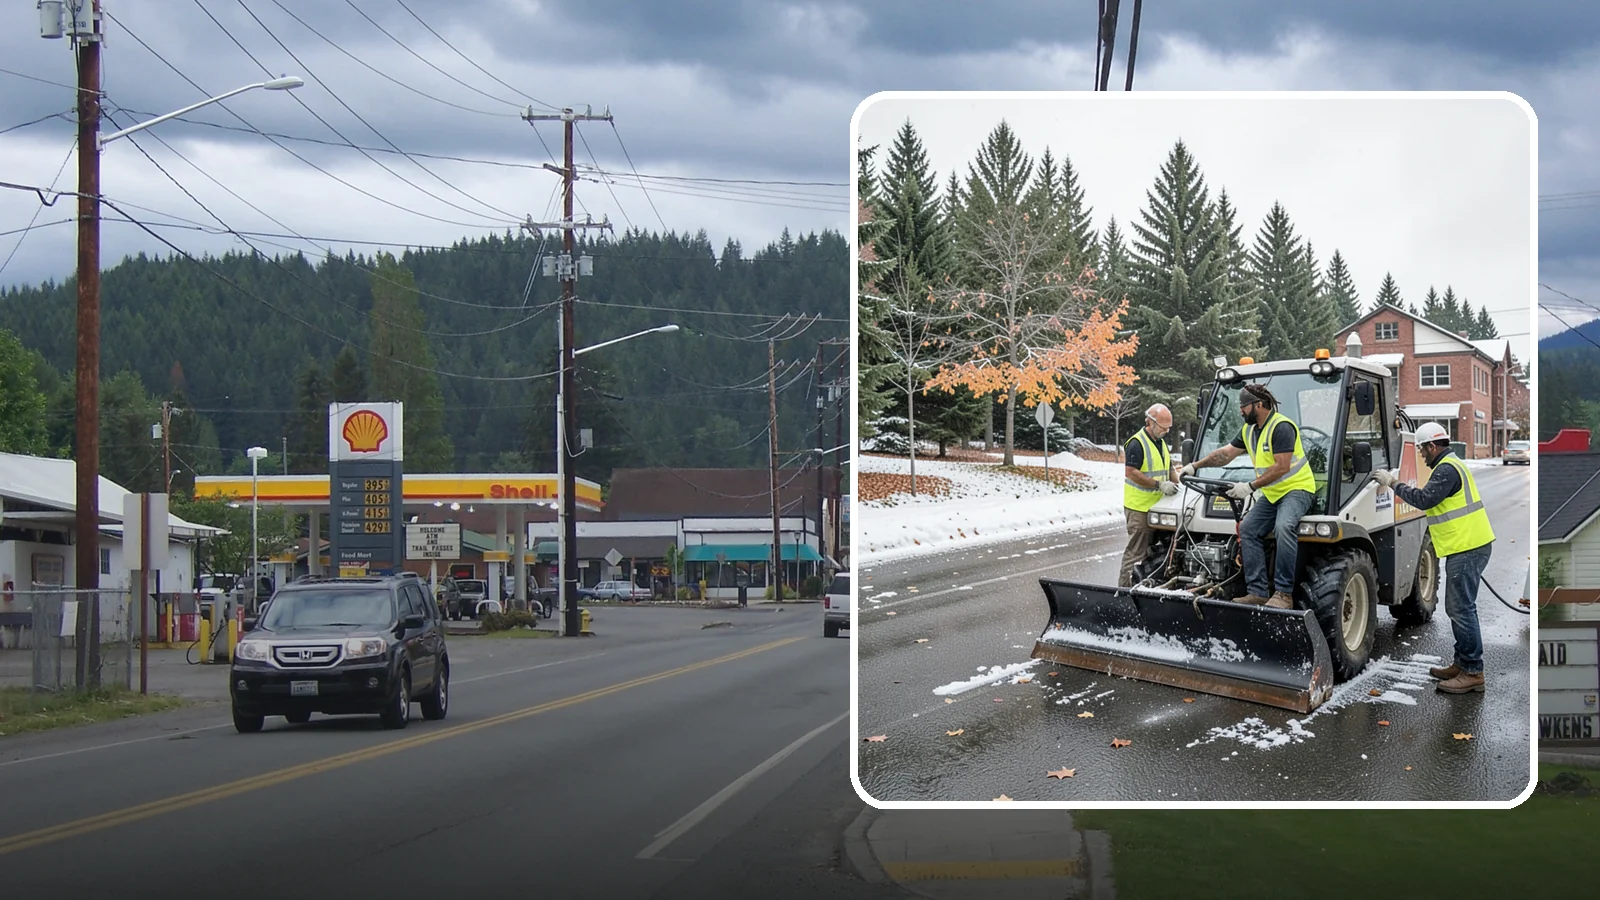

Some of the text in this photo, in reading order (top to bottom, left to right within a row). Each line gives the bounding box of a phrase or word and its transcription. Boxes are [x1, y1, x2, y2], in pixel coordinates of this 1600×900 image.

[365, 480, 384, 490] 395
[490, 484, 548, 499] Shell
[365, 494, 384, 504] 405
[365, 508, 384, 518] 415
[365, 522, 384, 533] 429
